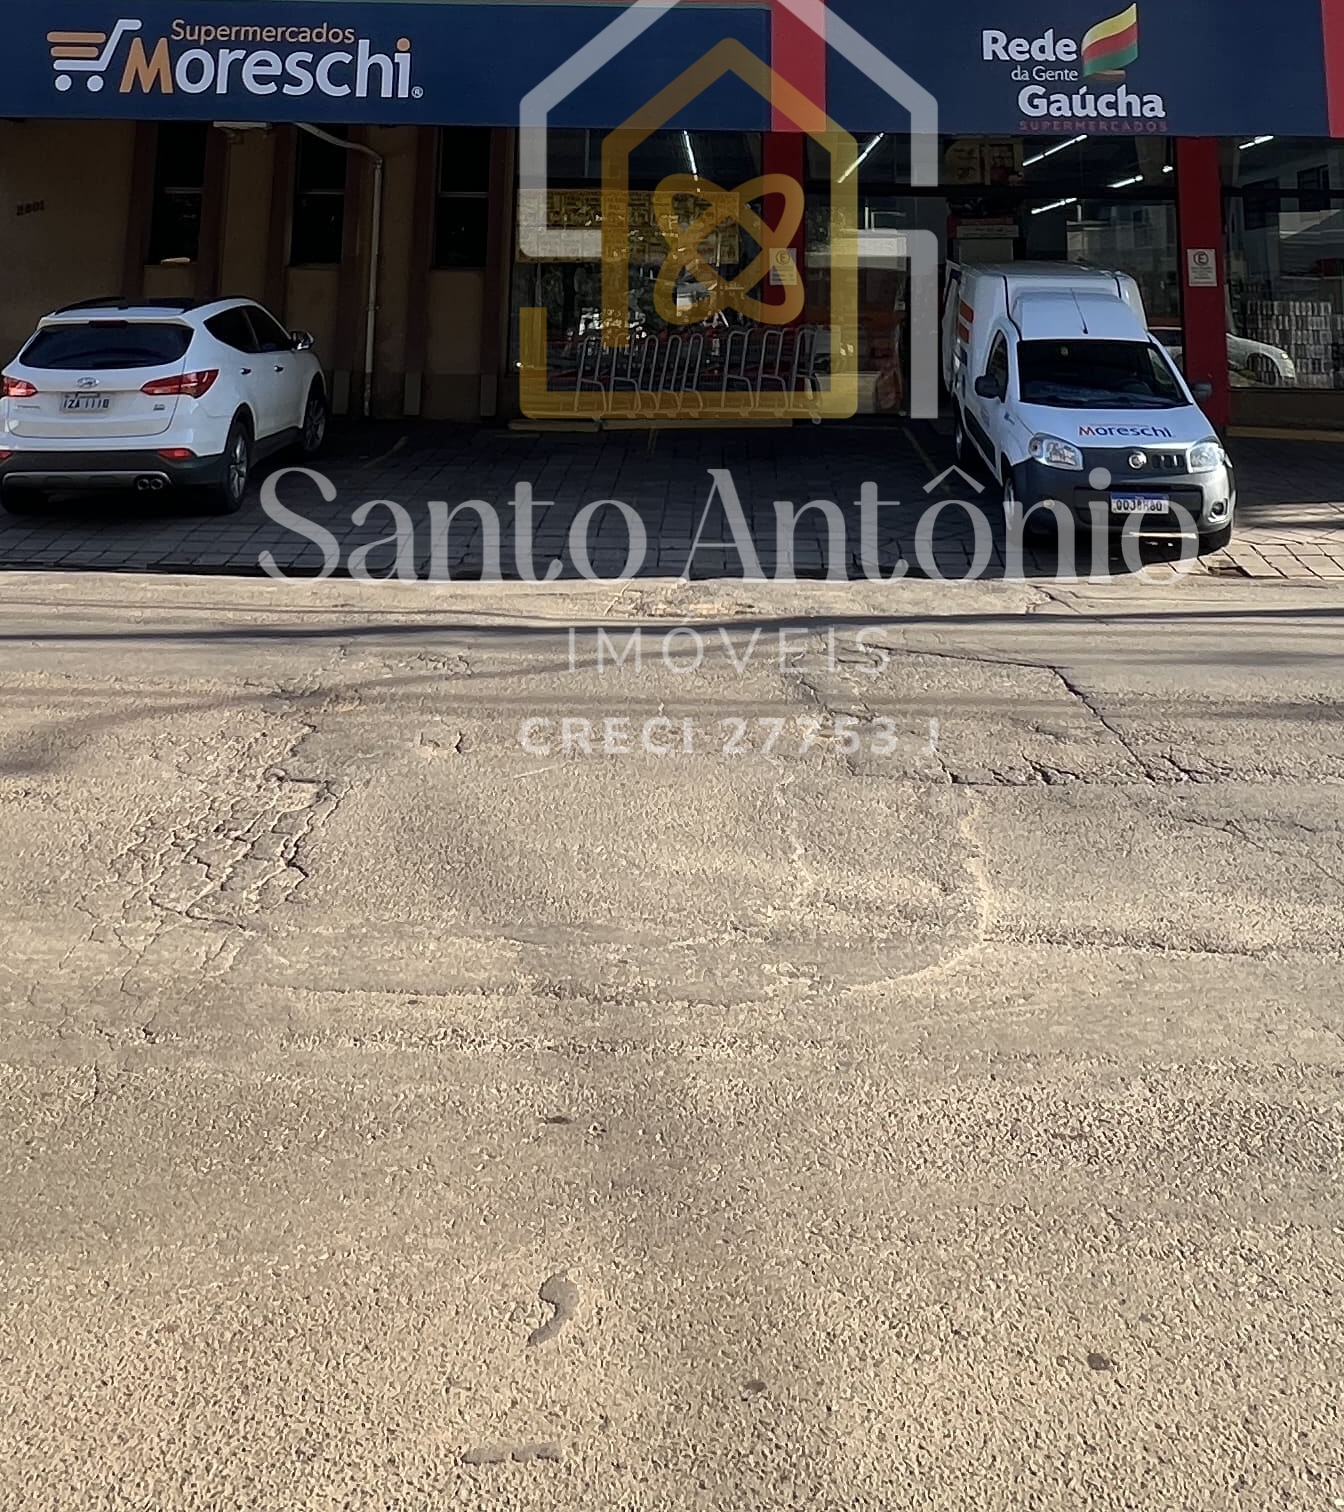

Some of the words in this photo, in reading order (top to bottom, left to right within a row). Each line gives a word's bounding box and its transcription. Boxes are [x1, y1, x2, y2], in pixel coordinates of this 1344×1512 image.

[171, 20, 355, 45] Supermercados
[982, 29, 1077, 61] Rede
[119, 38, 411, 98] Moreschi
[1011, 65, 1030, 81] da
[1032, 66, 1078, 81] Gente
[1018, 84, 1166, 118] Gaúcha
[1019, 120, 1168, 133] SUPERMERCADOS
[1079, 426, 1173, 438] Moreschi
